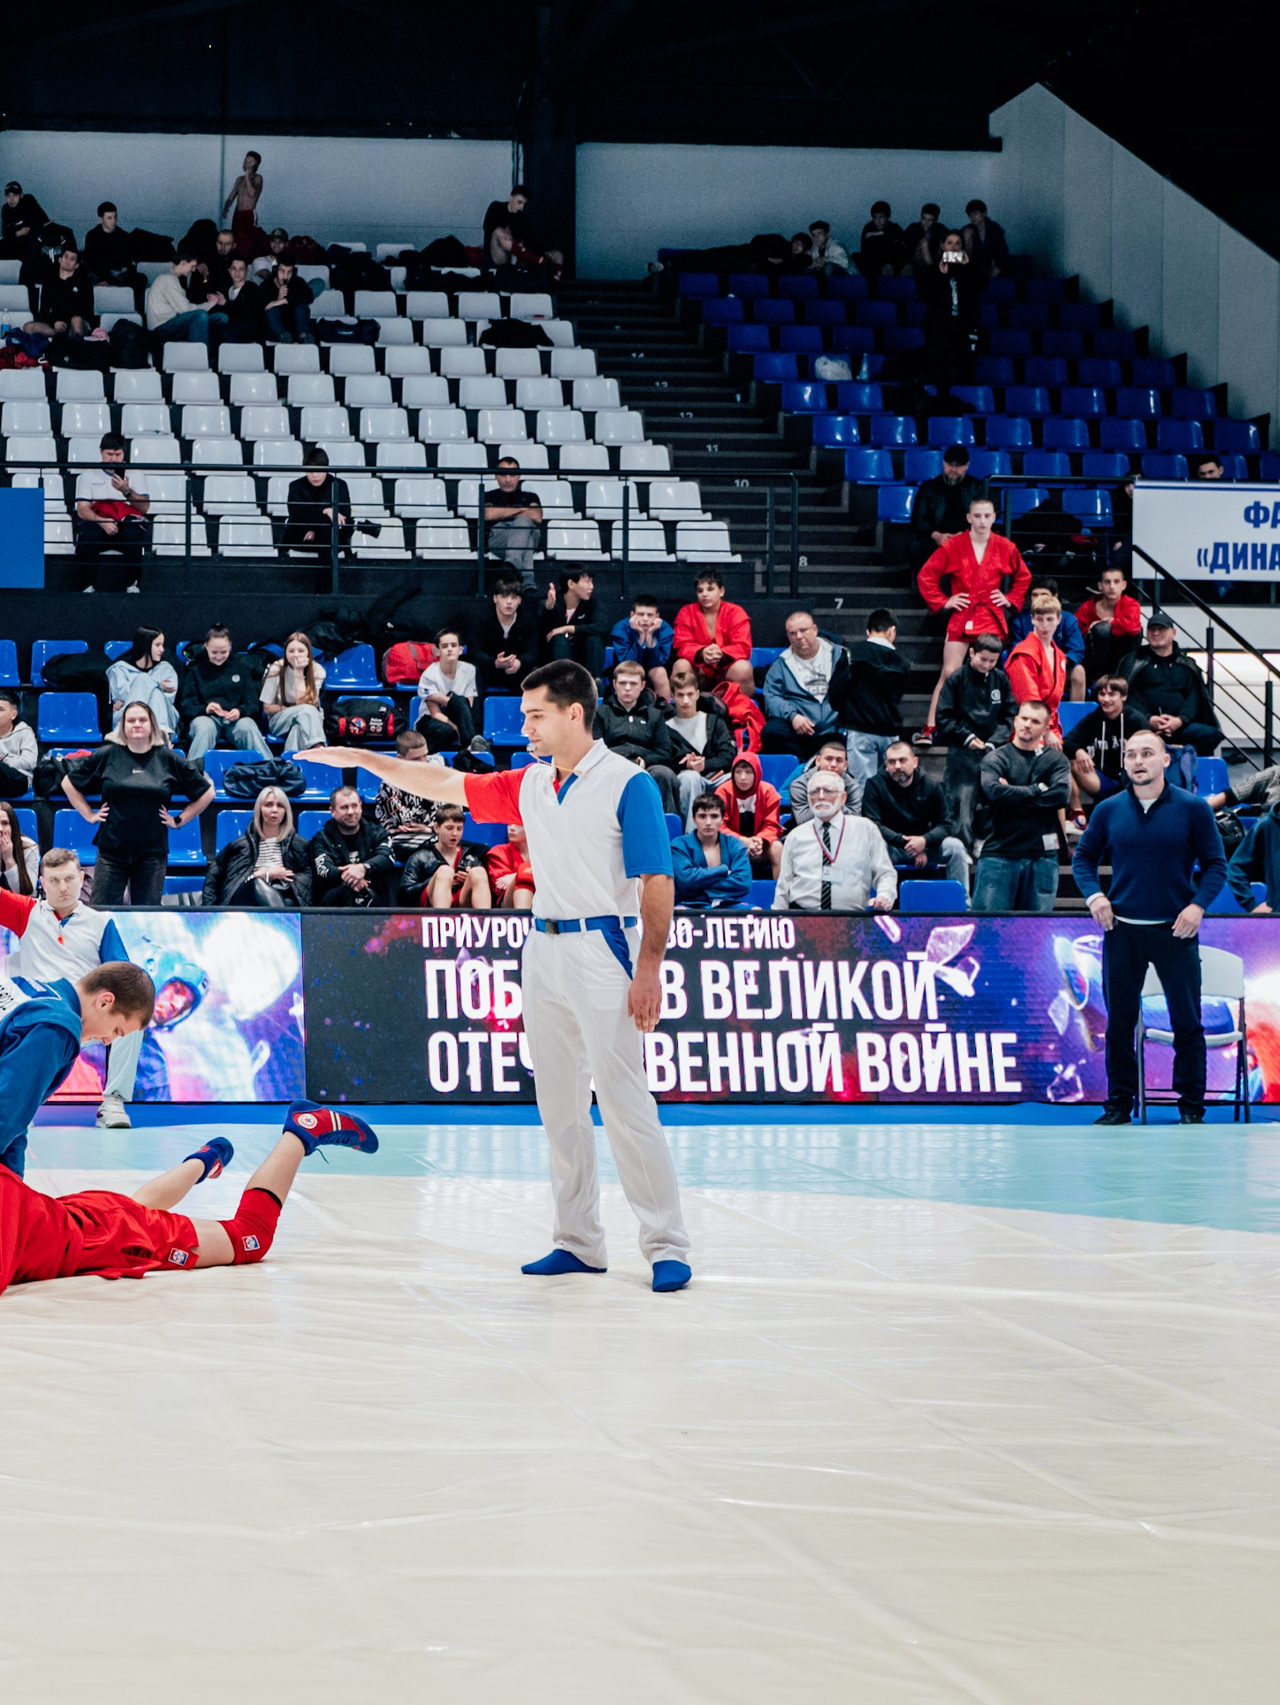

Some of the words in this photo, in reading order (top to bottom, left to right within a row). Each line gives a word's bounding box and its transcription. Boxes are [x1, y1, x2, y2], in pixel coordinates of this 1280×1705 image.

[798, 555, 809, 567] 8
[834, 598, 844, 610] 7
[421, 915, 535, 948] ПРИУРО
[424, 959, 523, 1019] ПОБ
[659, 960, 688, 1019] В
[700, 952, 939, 1020] ВЕЛИКОЙ
[856, 1023, 1022, 1092] ВОЙНЕ
